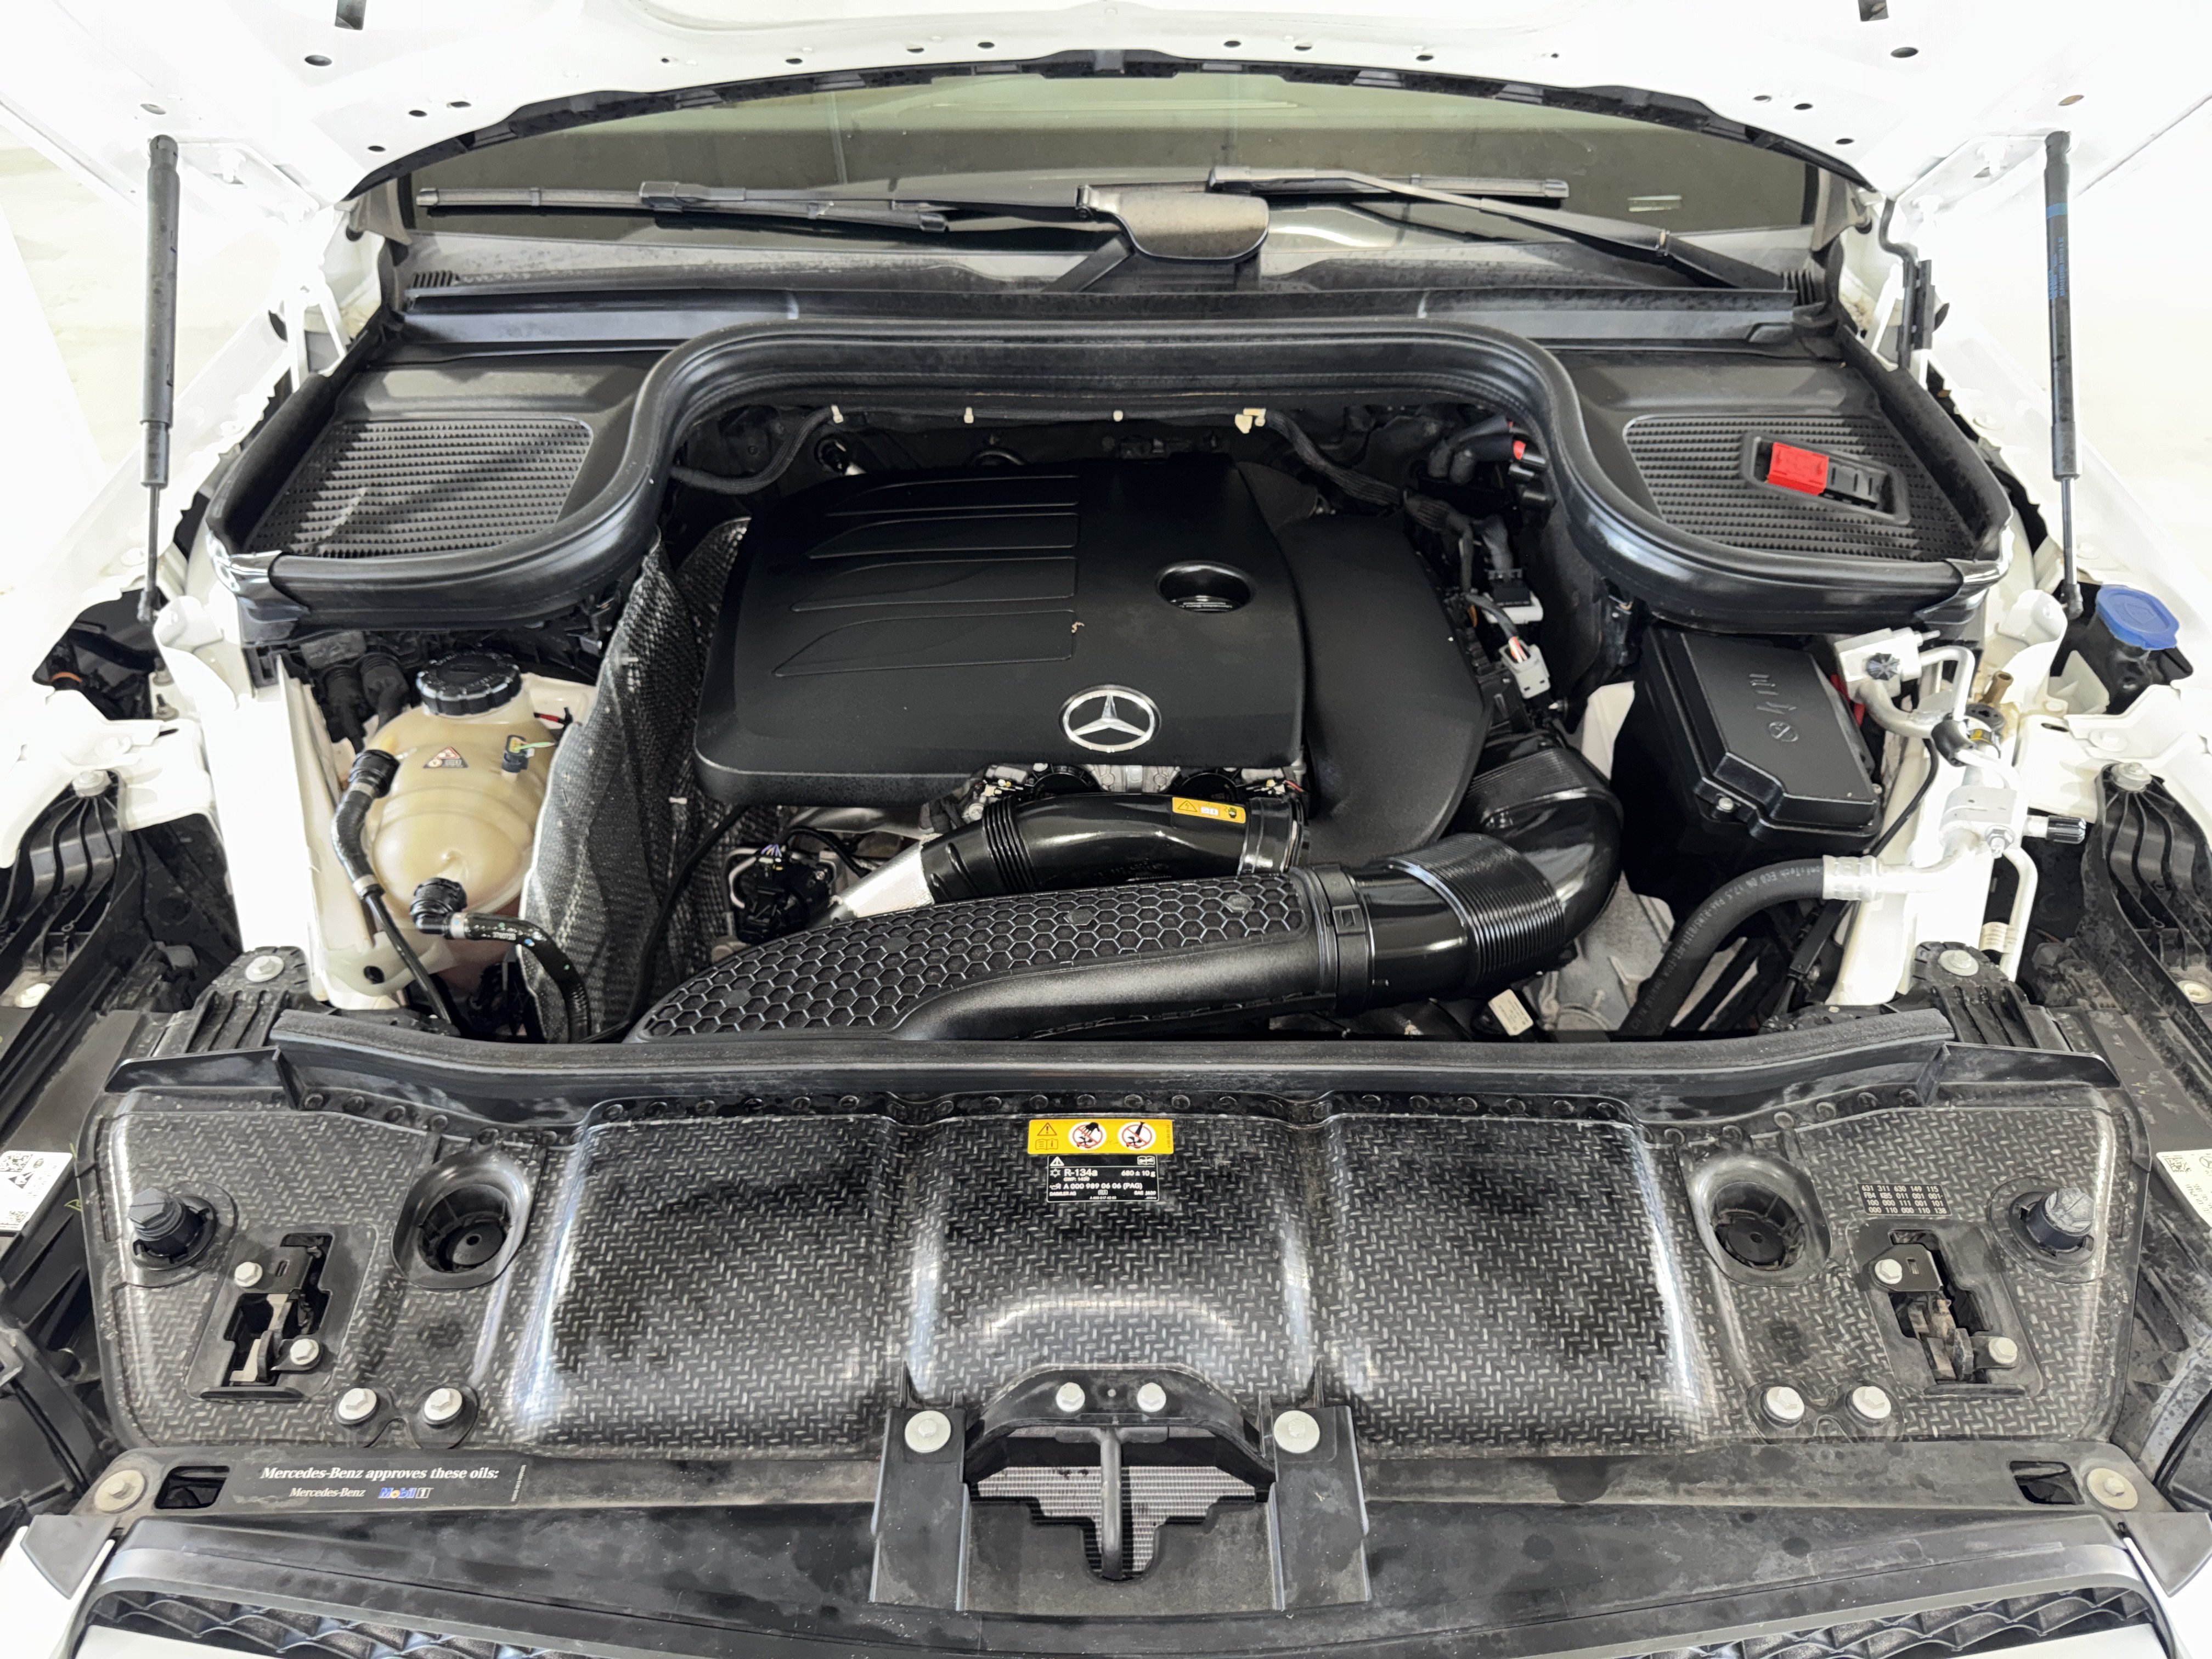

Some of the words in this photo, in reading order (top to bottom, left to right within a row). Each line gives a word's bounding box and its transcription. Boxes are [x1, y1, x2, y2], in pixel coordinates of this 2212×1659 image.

[260, 1468, 363, 1479] Mercedes-Benz
[365, 1470, 427, 1481] approves
[430, 1468, 467, 1479] these
[469, 1469, 499, 1479] oils:
[289, 1488, 365, 1497] Mercedes-Benz
[378, 1488, 416, 1498] Mobil
